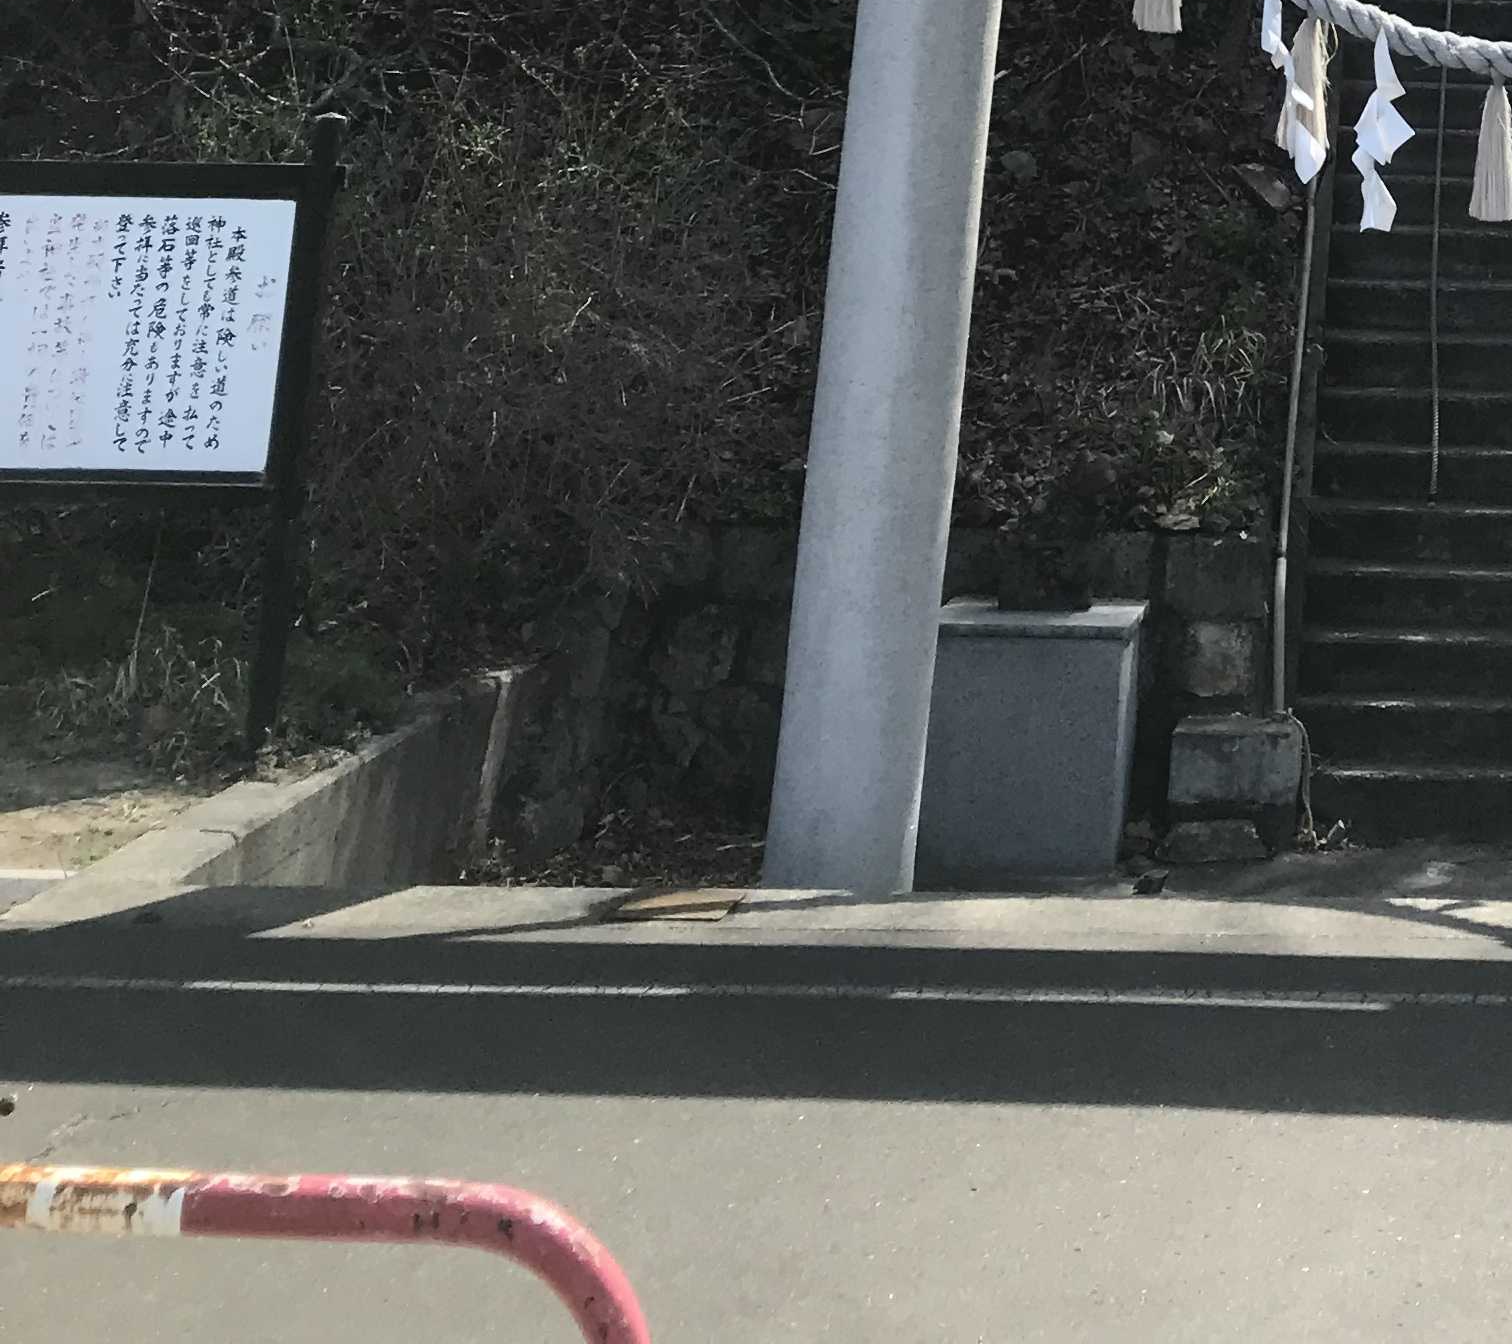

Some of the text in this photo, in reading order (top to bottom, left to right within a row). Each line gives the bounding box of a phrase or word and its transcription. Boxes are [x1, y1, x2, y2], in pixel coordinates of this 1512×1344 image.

[108, 214, 134, 298] 登って下さい
[113, 214, 157, 452] 参拝に当たっては充分に注意して
[134, 214, 180, 454] 落石等の危険もありますので
[158, 216, 203, 448] 巡回等をしておりますが途中
[182, 215, 227, 450] 神社としても常に注意を払って
[204, 225, 247, 450] 本殿参道は険しい道のため
